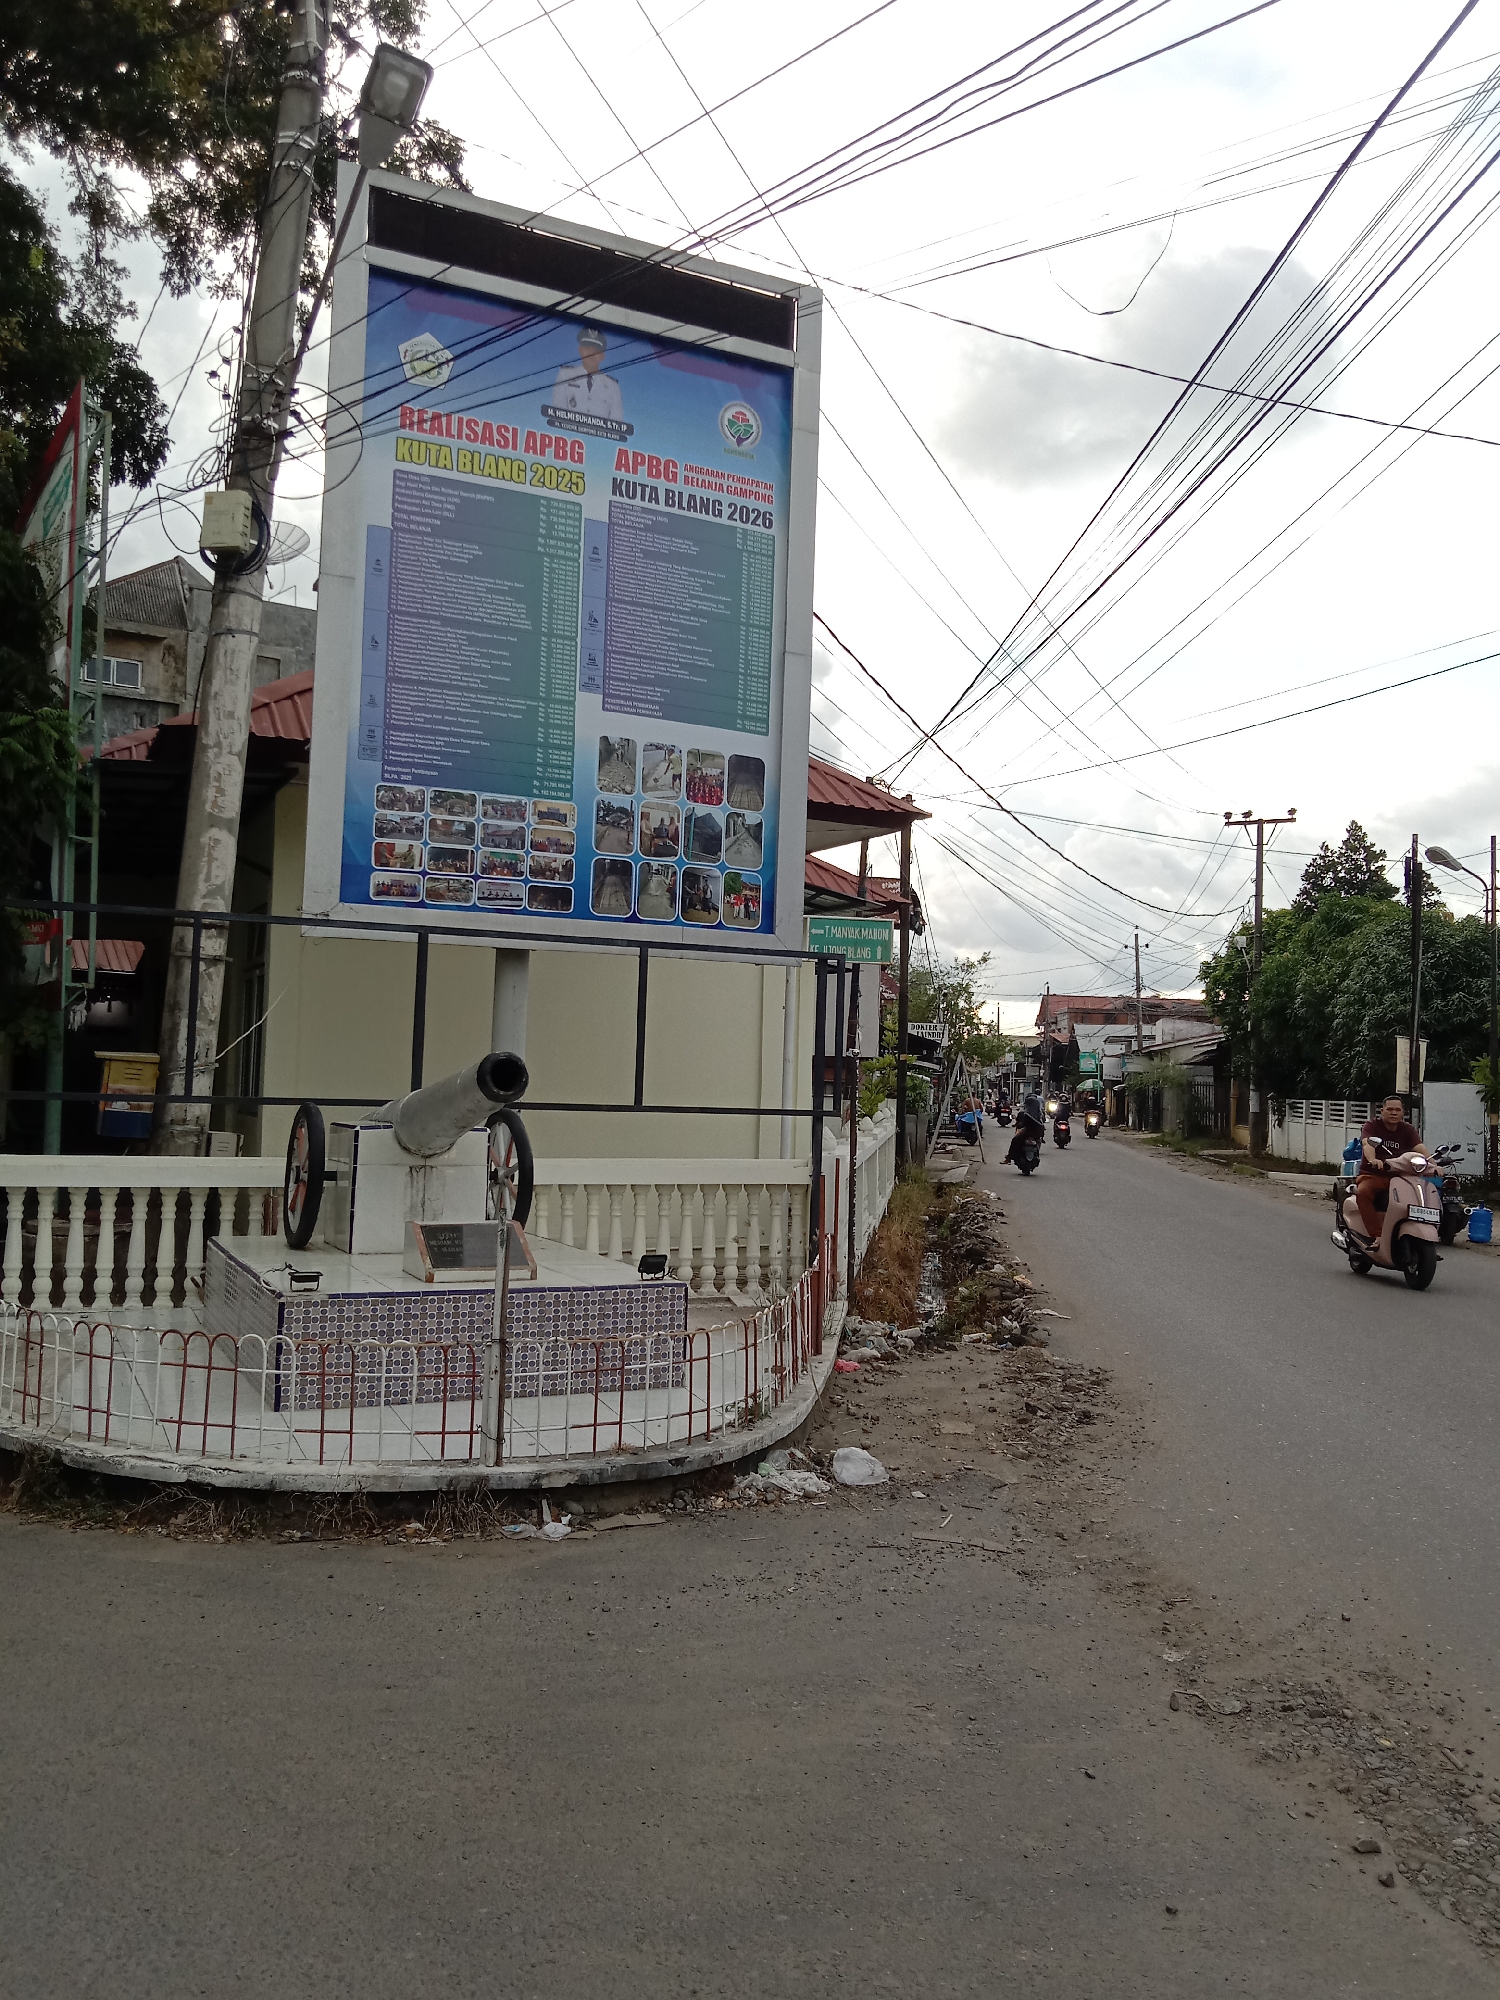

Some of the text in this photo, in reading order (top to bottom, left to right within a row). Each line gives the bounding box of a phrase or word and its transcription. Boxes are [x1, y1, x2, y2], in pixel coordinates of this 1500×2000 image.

[399, 404, 585, 466] REALISASI APBG
[395, 436, 586, 496] KUTA BLANG 2025
[614, 447, 679, 485] APBG
[683, 462, 774, 493] ANGGARAN PENDAPATAN
[611, 477, 774, 530] KUTA BLANG 2026
[683, 474, 774, 506] BELANJA GAMPONG
[847, 946, 871, 959] BLANG
